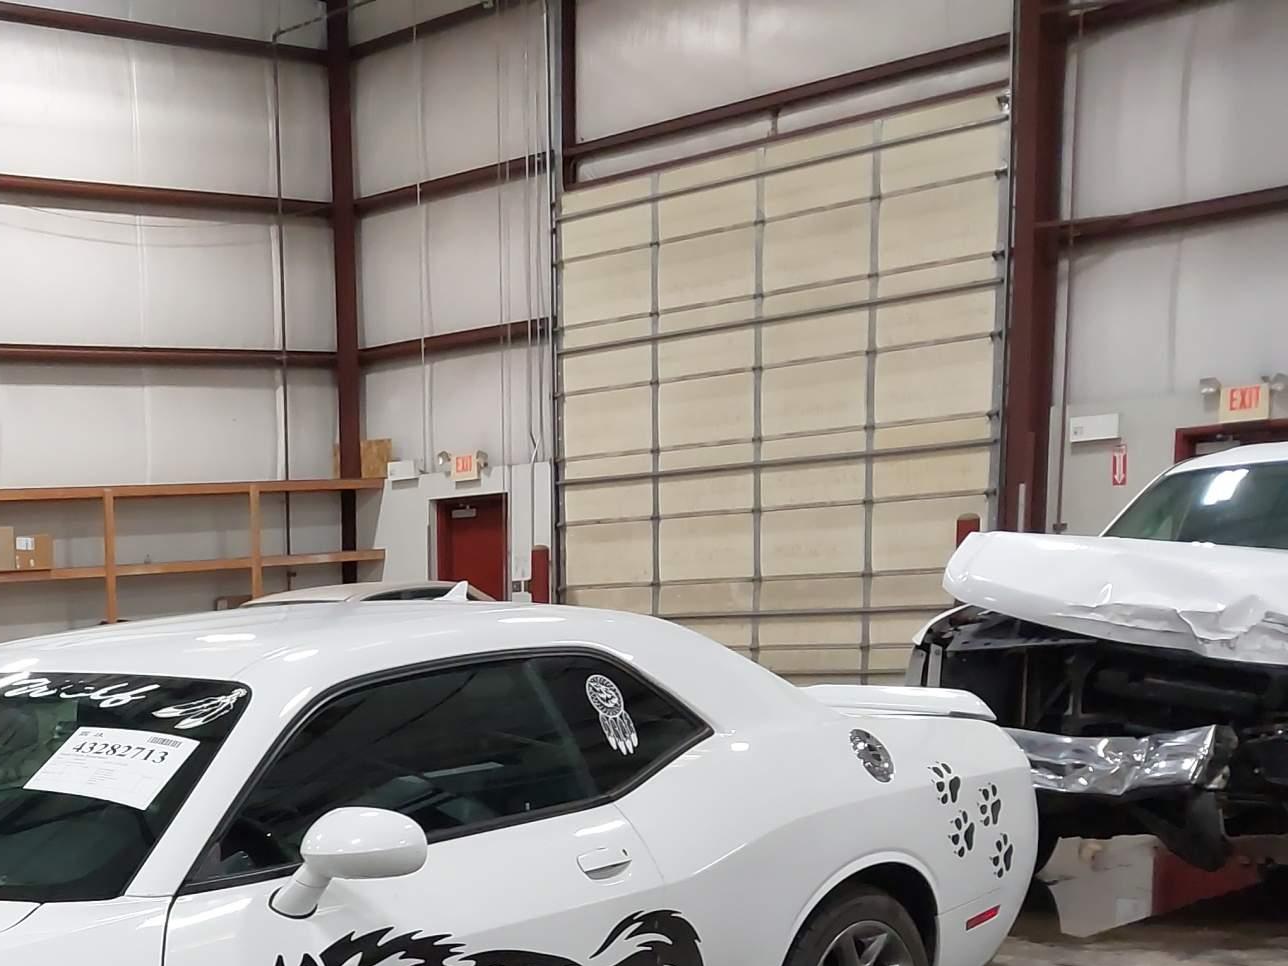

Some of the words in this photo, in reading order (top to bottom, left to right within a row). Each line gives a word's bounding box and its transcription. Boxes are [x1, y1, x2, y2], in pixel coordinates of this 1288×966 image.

[1229, 385, 1260, 411] EXIT
[455, 455, 473, 473] EXIT
[72, 741, 169, 764] 43282713
